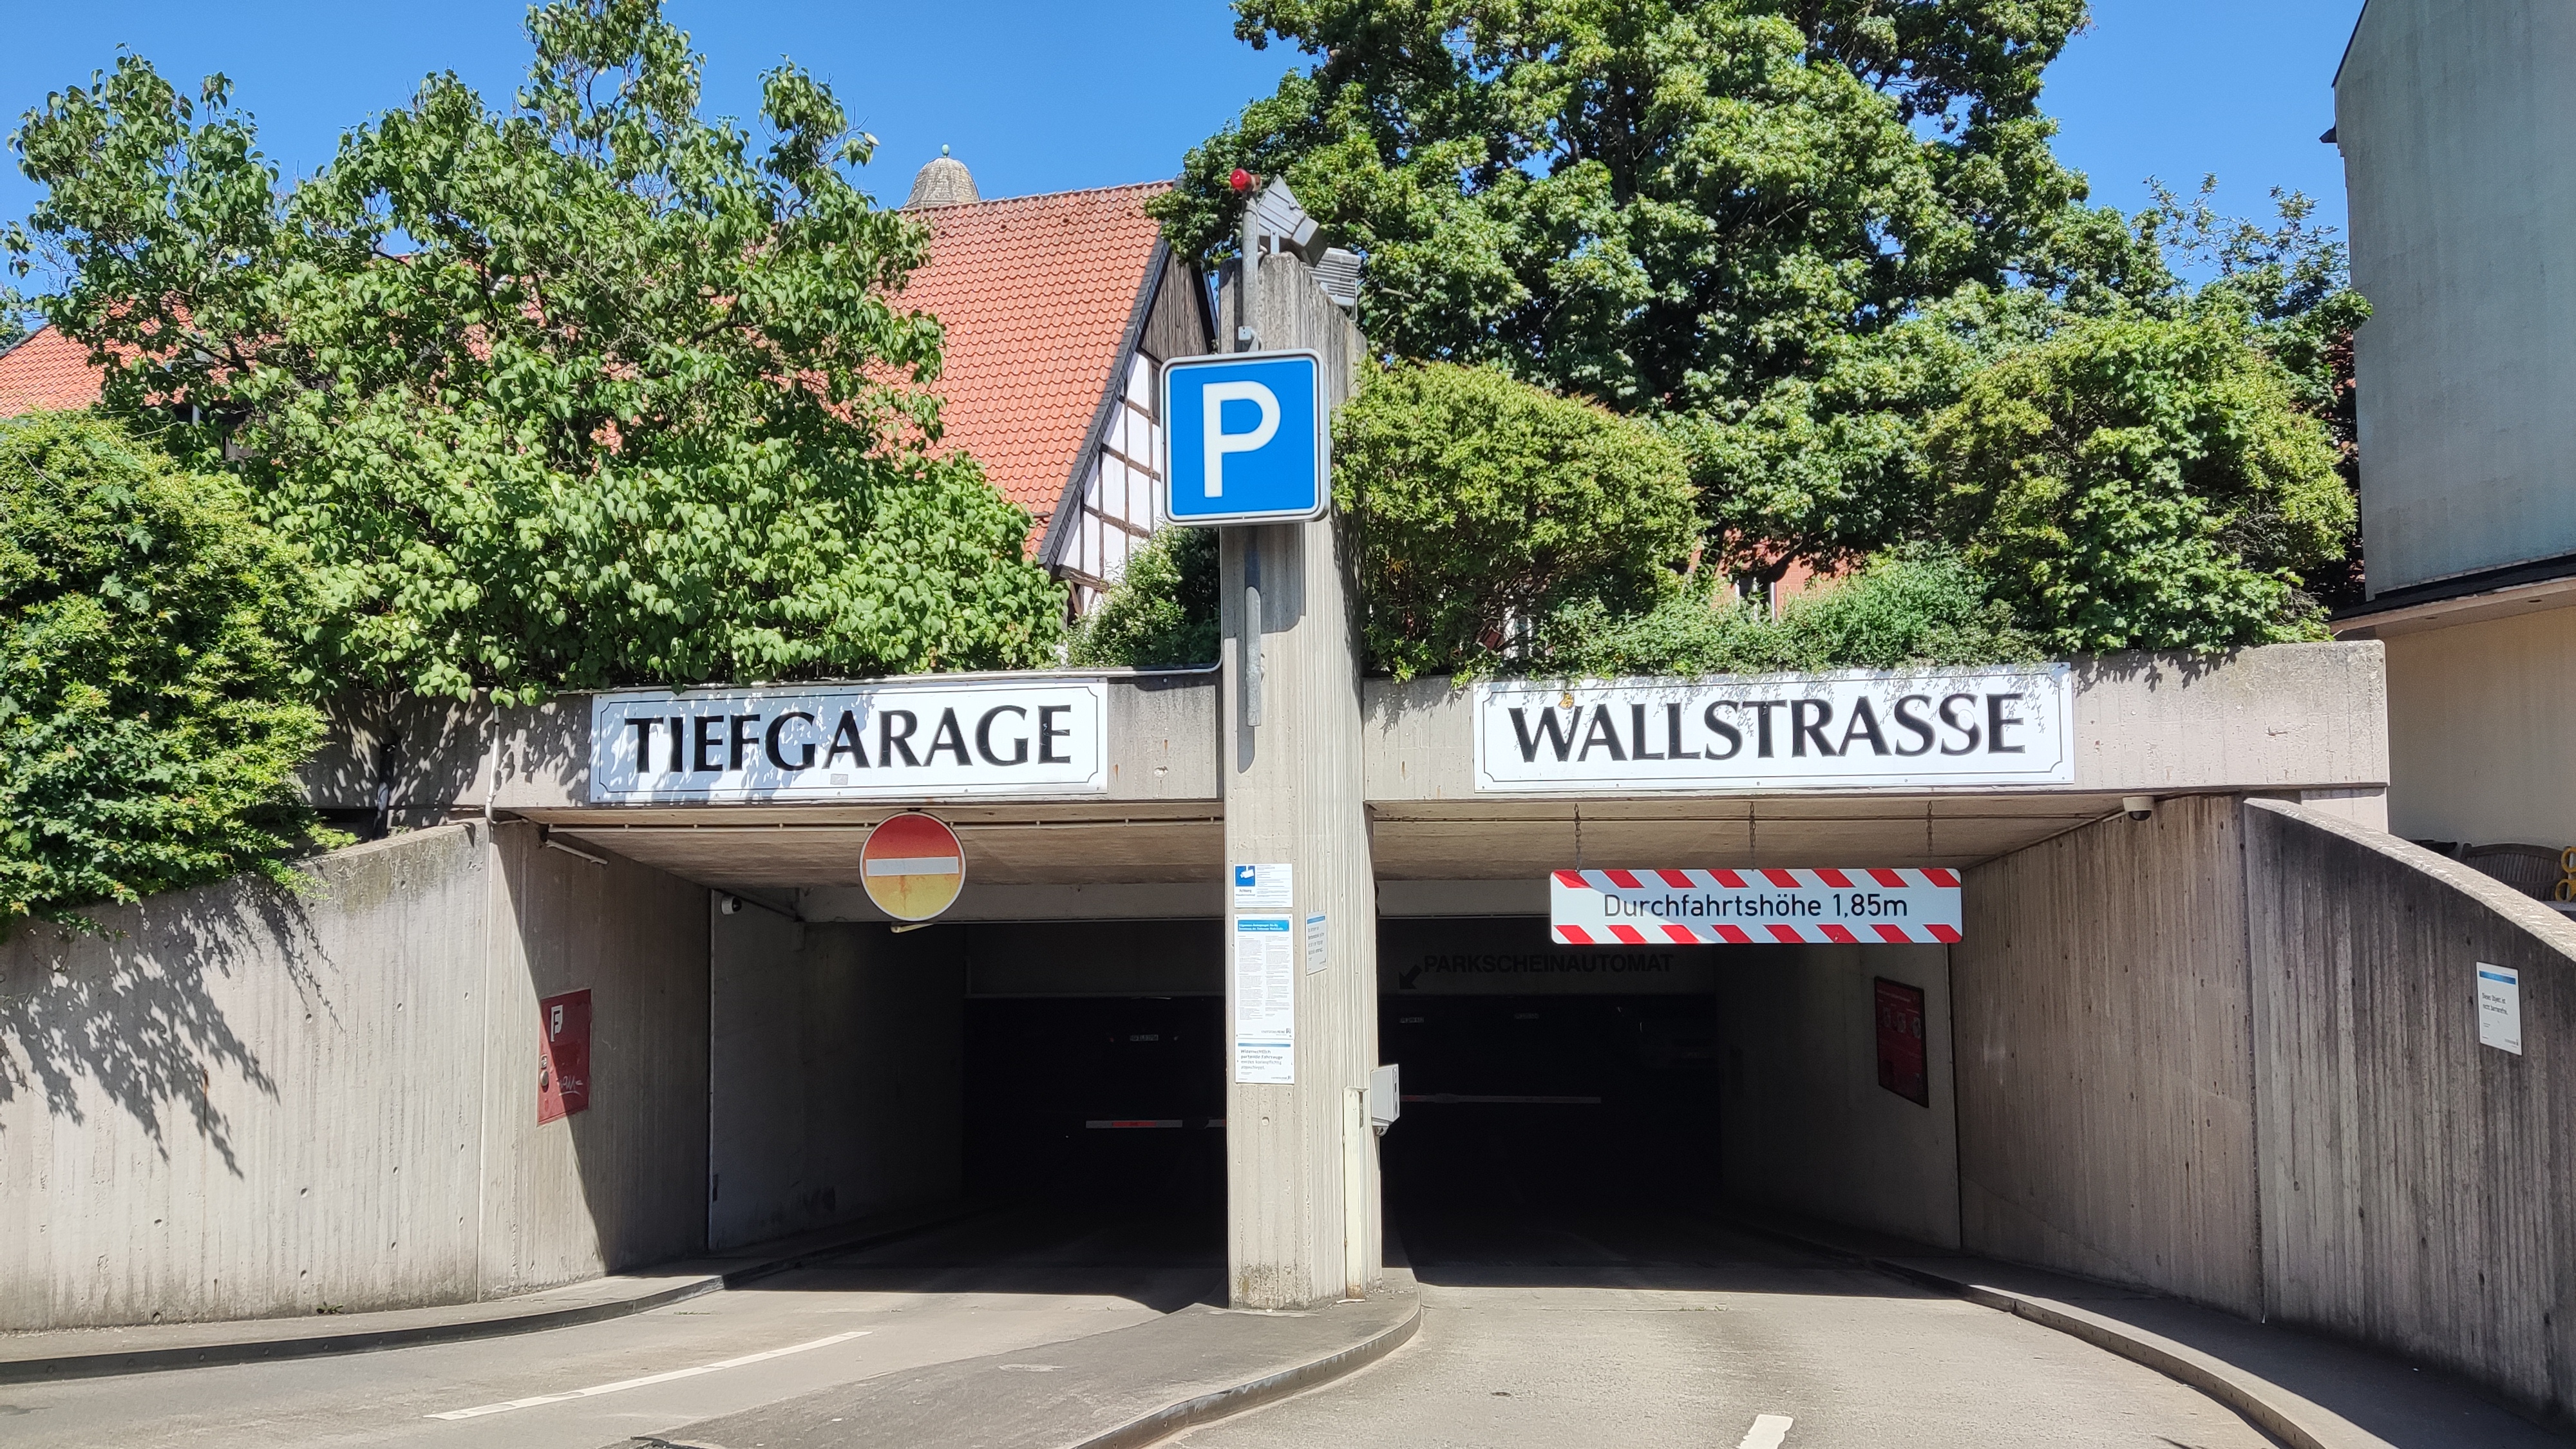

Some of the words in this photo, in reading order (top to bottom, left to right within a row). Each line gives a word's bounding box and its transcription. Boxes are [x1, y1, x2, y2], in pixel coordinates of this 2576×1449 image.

[1202, 381, 1281, 498] P
[624, 705, 1072, 773] TIEFGARAGE
[1507, 693, 2026, 763] WALLSTRASSE
[1604, 893, 1821, 918] Durchfahrtshöhe
[1833, 893, 1908, 920] 1,85m
[1424, 954, 1674, 973] PARKSCHEINAUTOMAT
